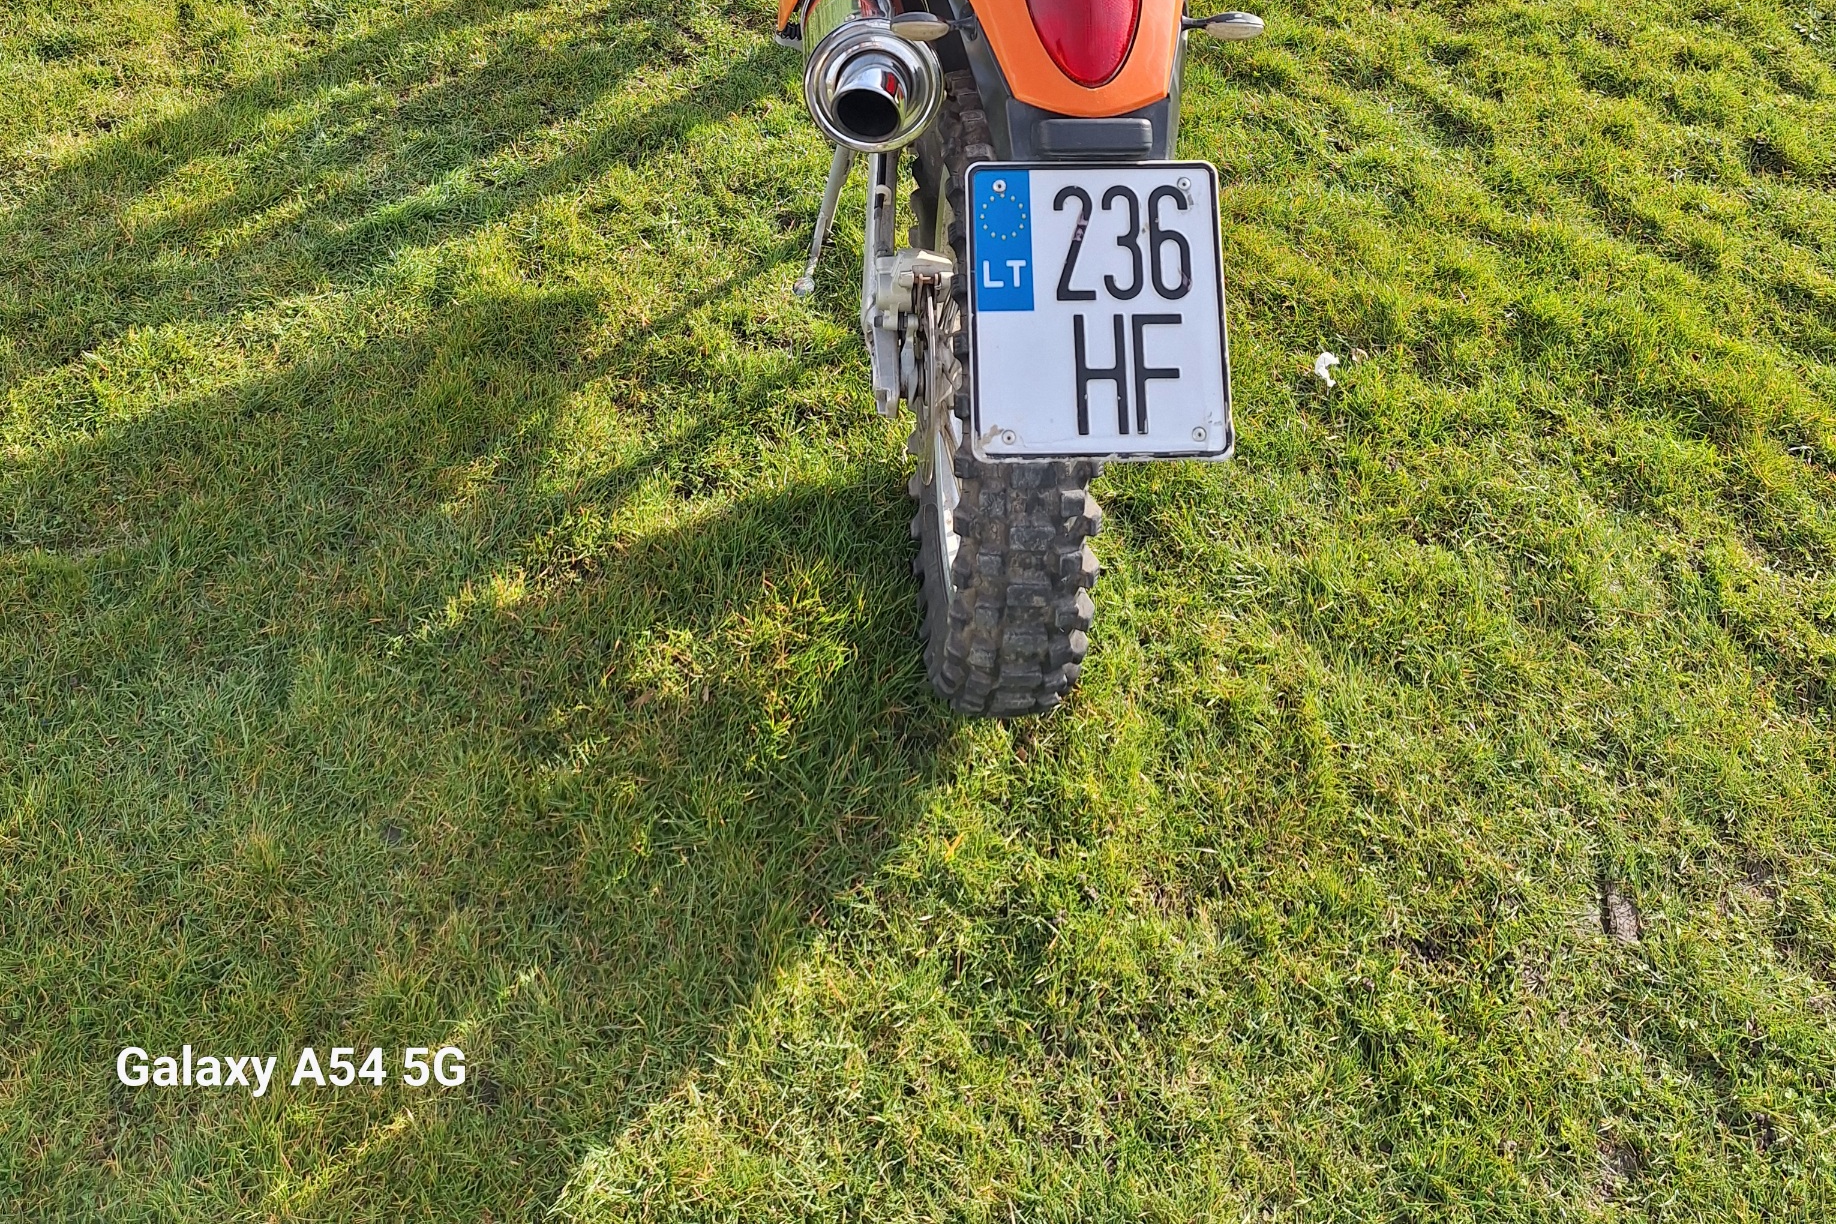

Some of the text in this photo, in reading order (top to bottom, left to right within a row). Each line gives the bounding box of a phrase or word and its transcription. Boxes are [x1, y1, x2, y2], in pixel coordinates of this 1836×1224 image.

[983, 259, 1027, 289] LT
[1053, 185, 1192, 301] 236
[1073, 313, 1183, 435] HF
